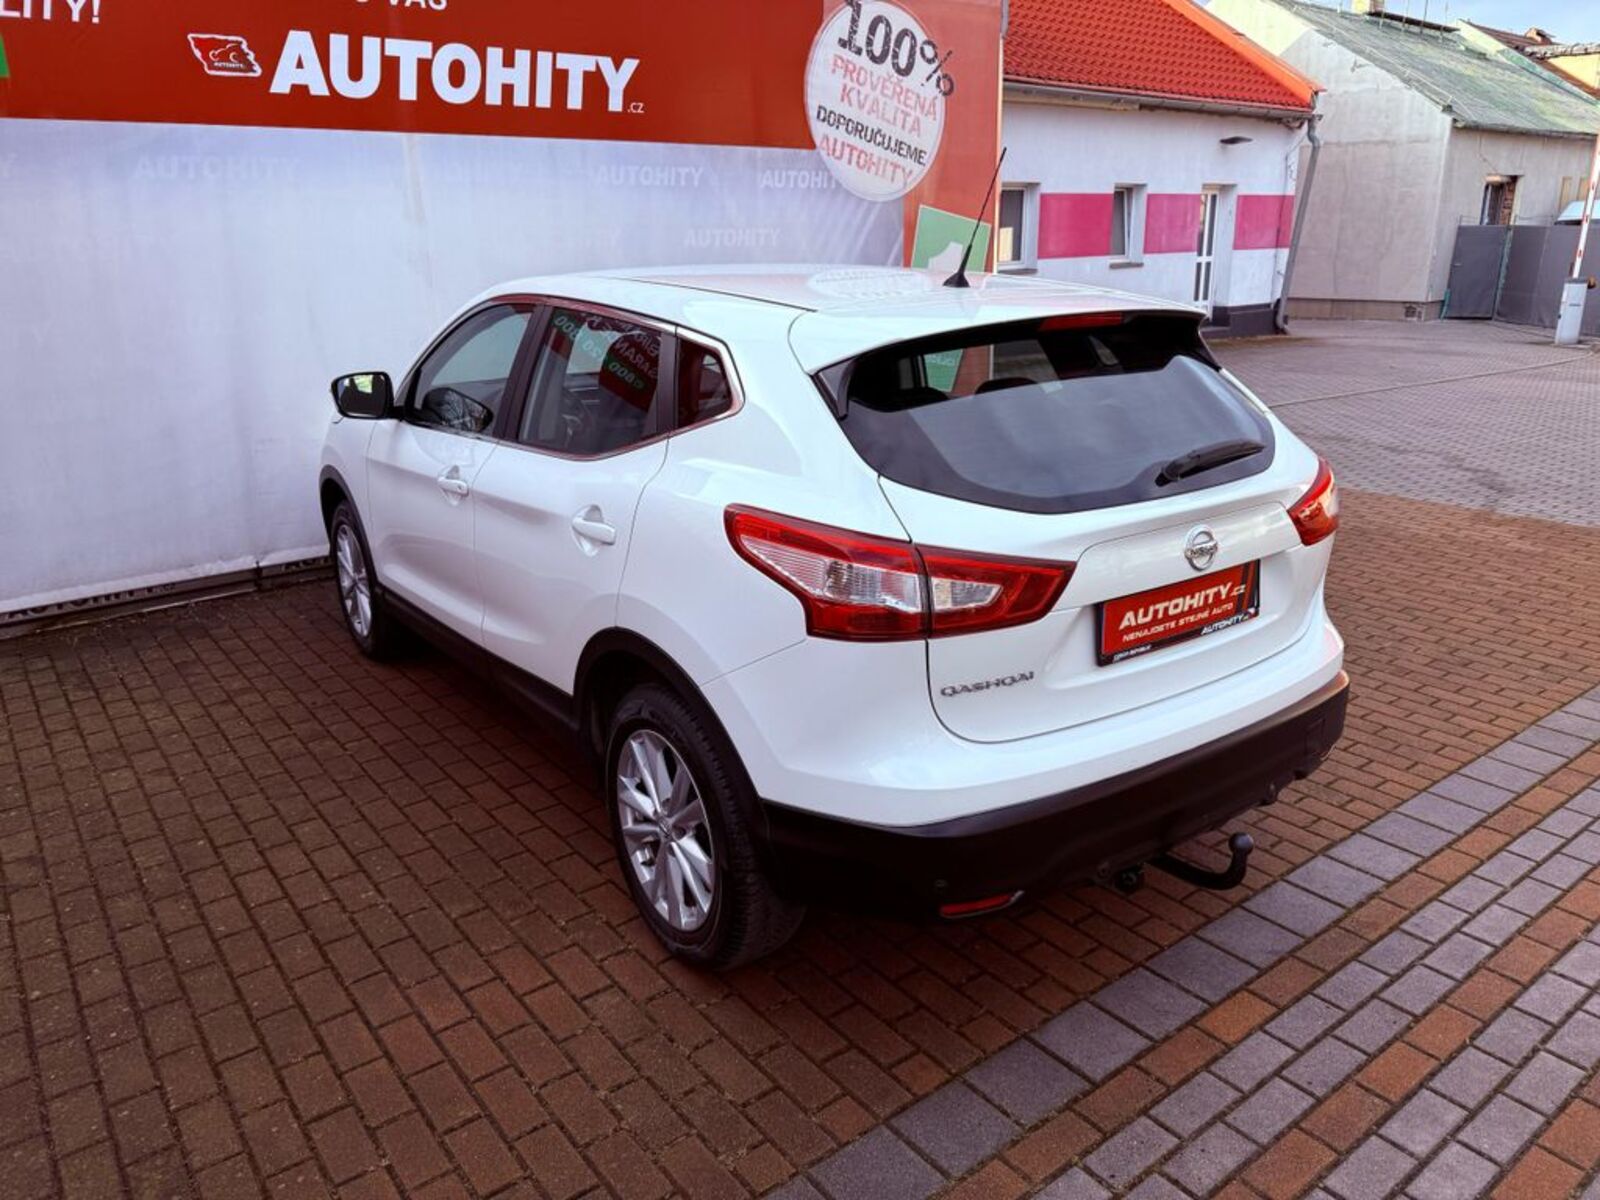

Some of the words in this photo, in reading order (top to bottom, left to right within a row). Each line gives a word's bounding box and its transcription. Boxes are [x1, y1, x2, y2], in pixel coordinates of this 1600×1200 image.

[837, 0, 954, 97] 100%
[831, 54, 938, 121] PROVĚŘENÁ
[840, 84, 922, 138] KVALITA
[816, 104, 928, 167] DOPORUČUJEME
[818, 133, 914, 187] AUTOHITY
[597, 165, 704, 187] AUTOHITY
[683, 227, 782, 249] AUTOHITY
[940, 671, 1034, 697] QASHQAI
